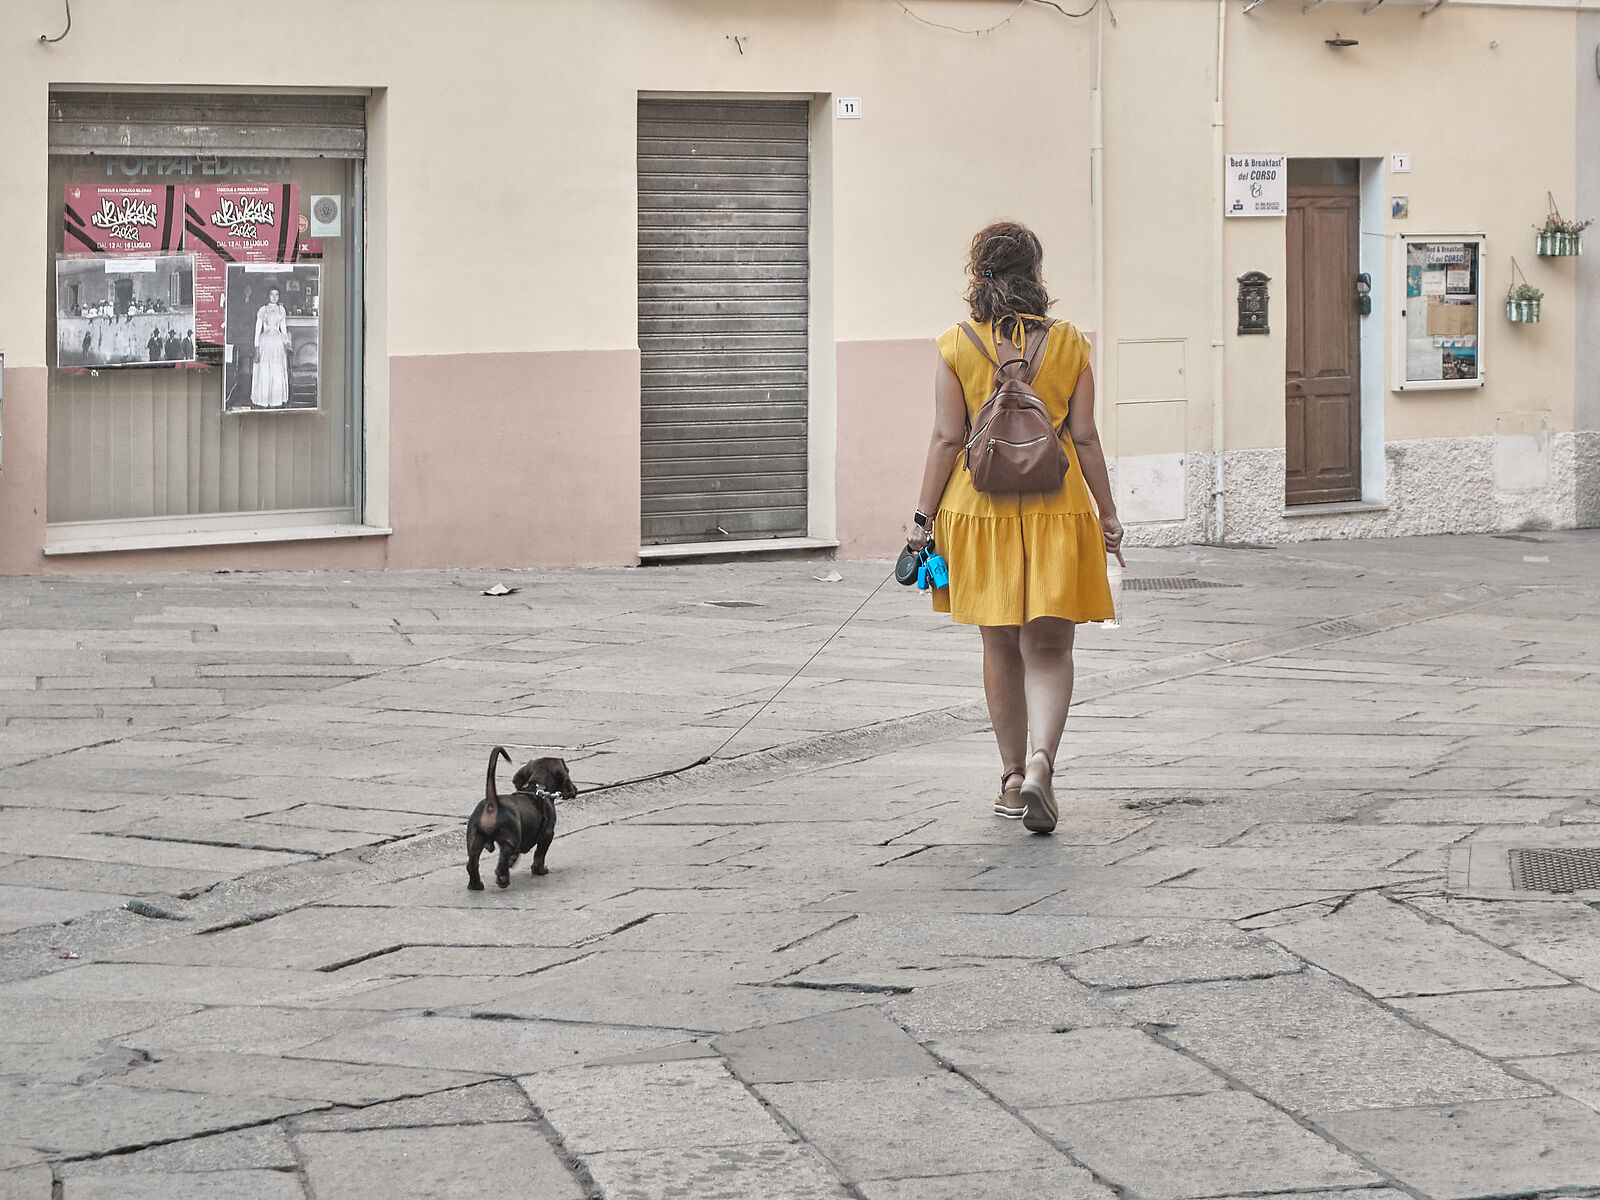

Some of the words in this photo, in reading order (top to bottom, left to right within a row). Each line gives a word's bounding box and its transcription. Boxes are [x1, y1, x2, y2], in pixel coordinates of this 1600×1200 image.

[844, 103, 854, 113] 11
[1230, 158, 1243, 167] Bed
[1244, 159, 1249, 167] &
[1251, 159, 1281, 167] Breakfast
[1238, 172, 1249, 180] del
[1250, 170, 1276, 180] CORSO
[109, 225, 139, 241] 2022
[228, 223, 257, 239] 2022
[1444, 254, 1463, 263] CORSO
